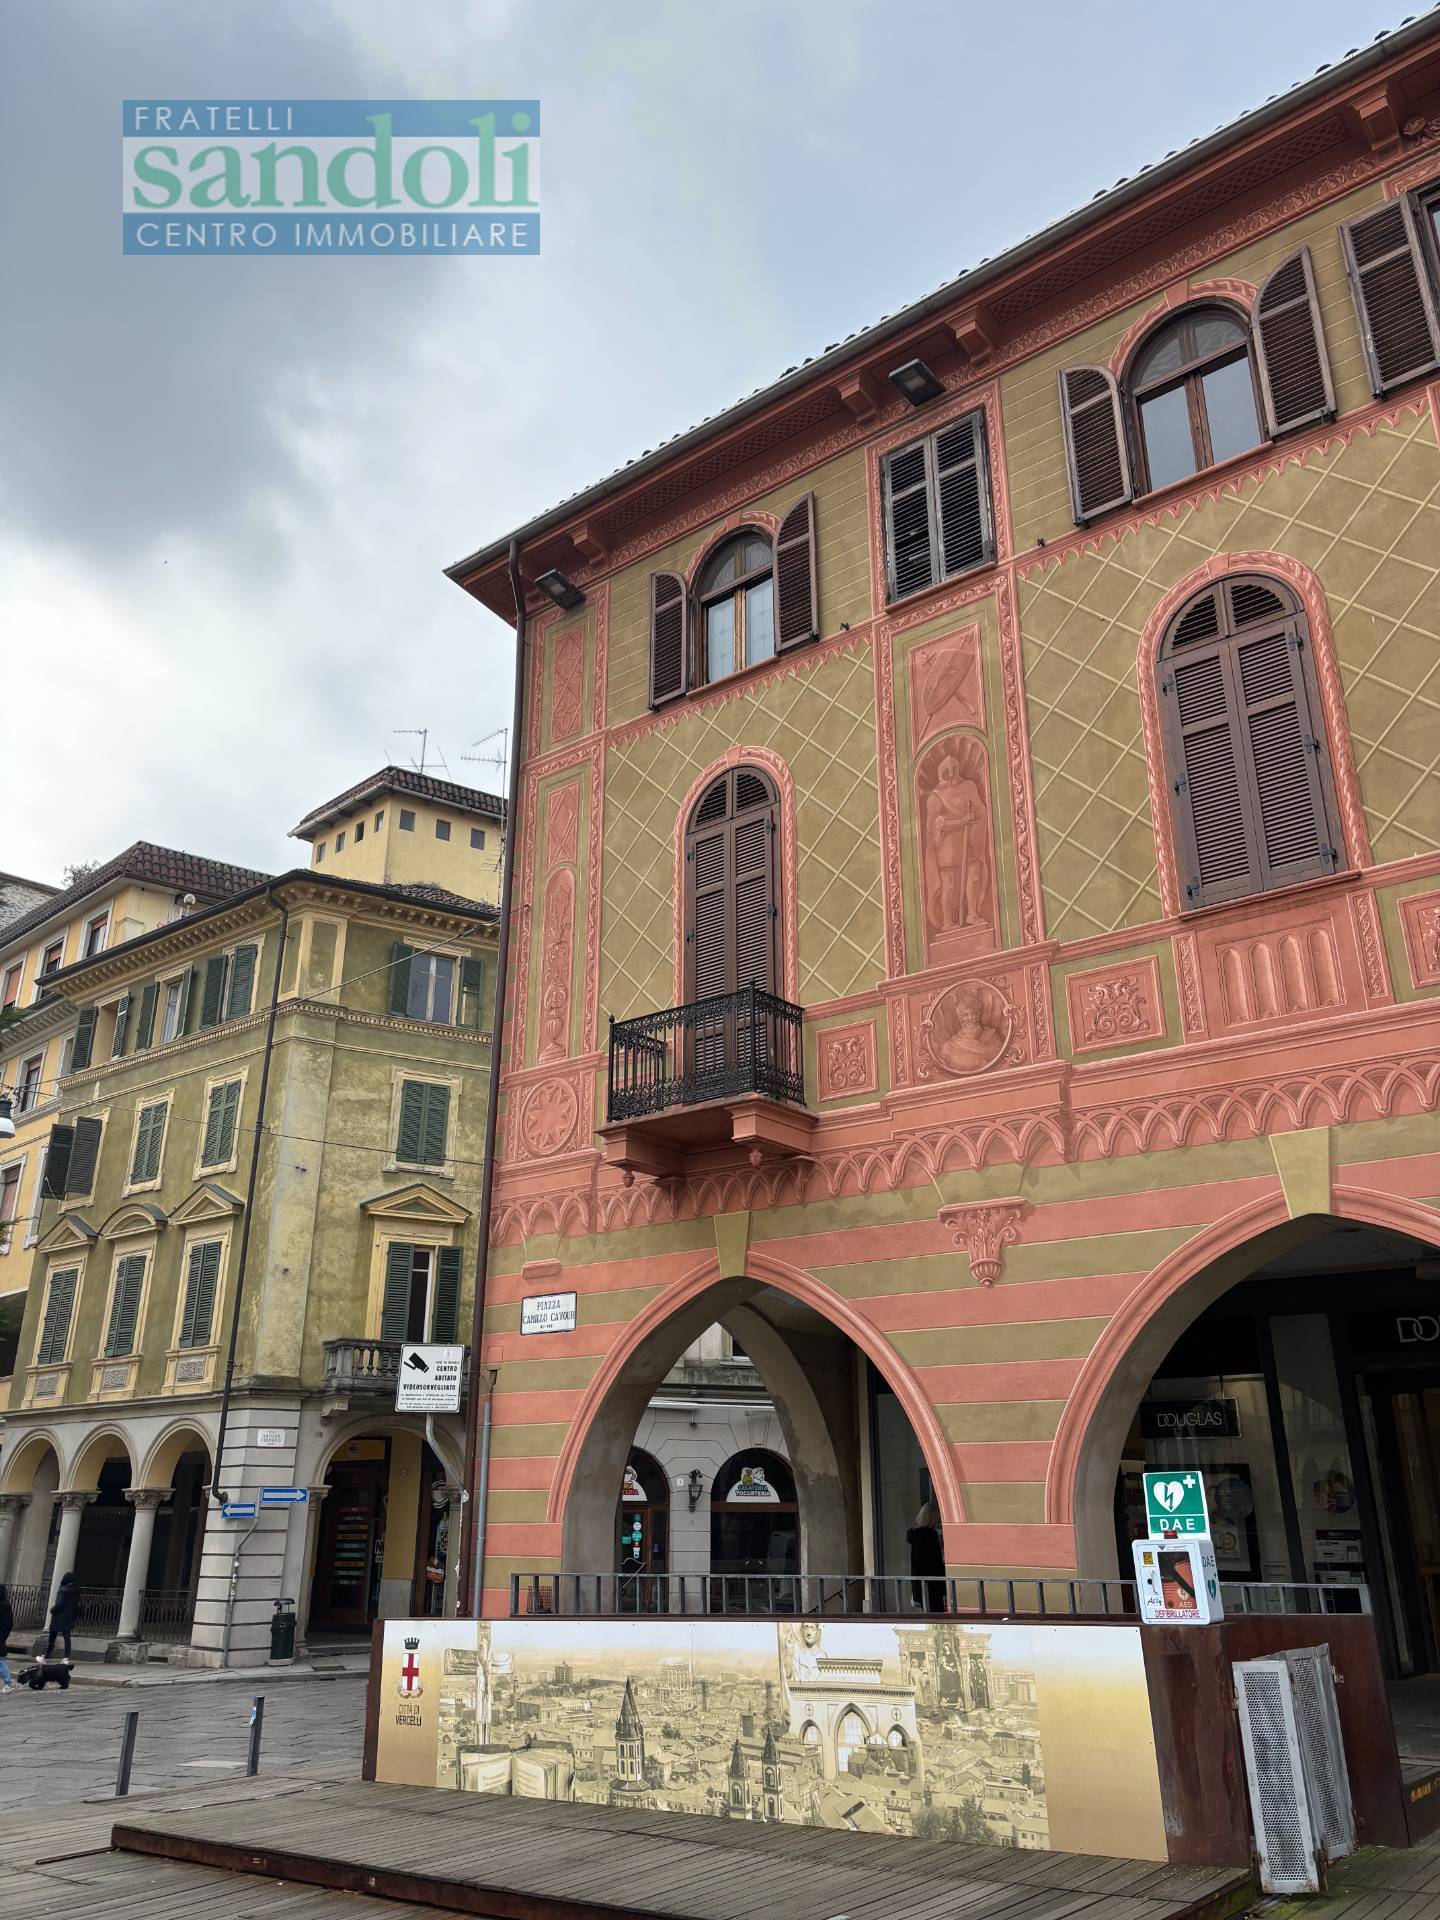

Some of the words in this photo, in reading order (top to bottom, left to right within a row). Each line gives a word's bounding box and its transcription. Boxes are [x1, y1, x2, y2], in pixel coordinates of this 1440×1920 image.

[536, 1299, 561, 1311] PIAZZA
[522, 1312, 548, 1325] CAMILLO
[550, 1310, 575, 1322] CAVOUR
[1396, 1313, 1440, 1343] DO
[403, 1383, 456, 1391] VIDEOSORVEGLIATO
[1156, 1411, 1223, 1428] DOUGLAS
[1159, 1518, 1196, 1531] DAE
[1201, 1555, 1215, 1567] DAE
[1154, 1609, 1201, 1618] DEFIBRILLATORE
[395, 1714, 422, 1727] VERCELLI
